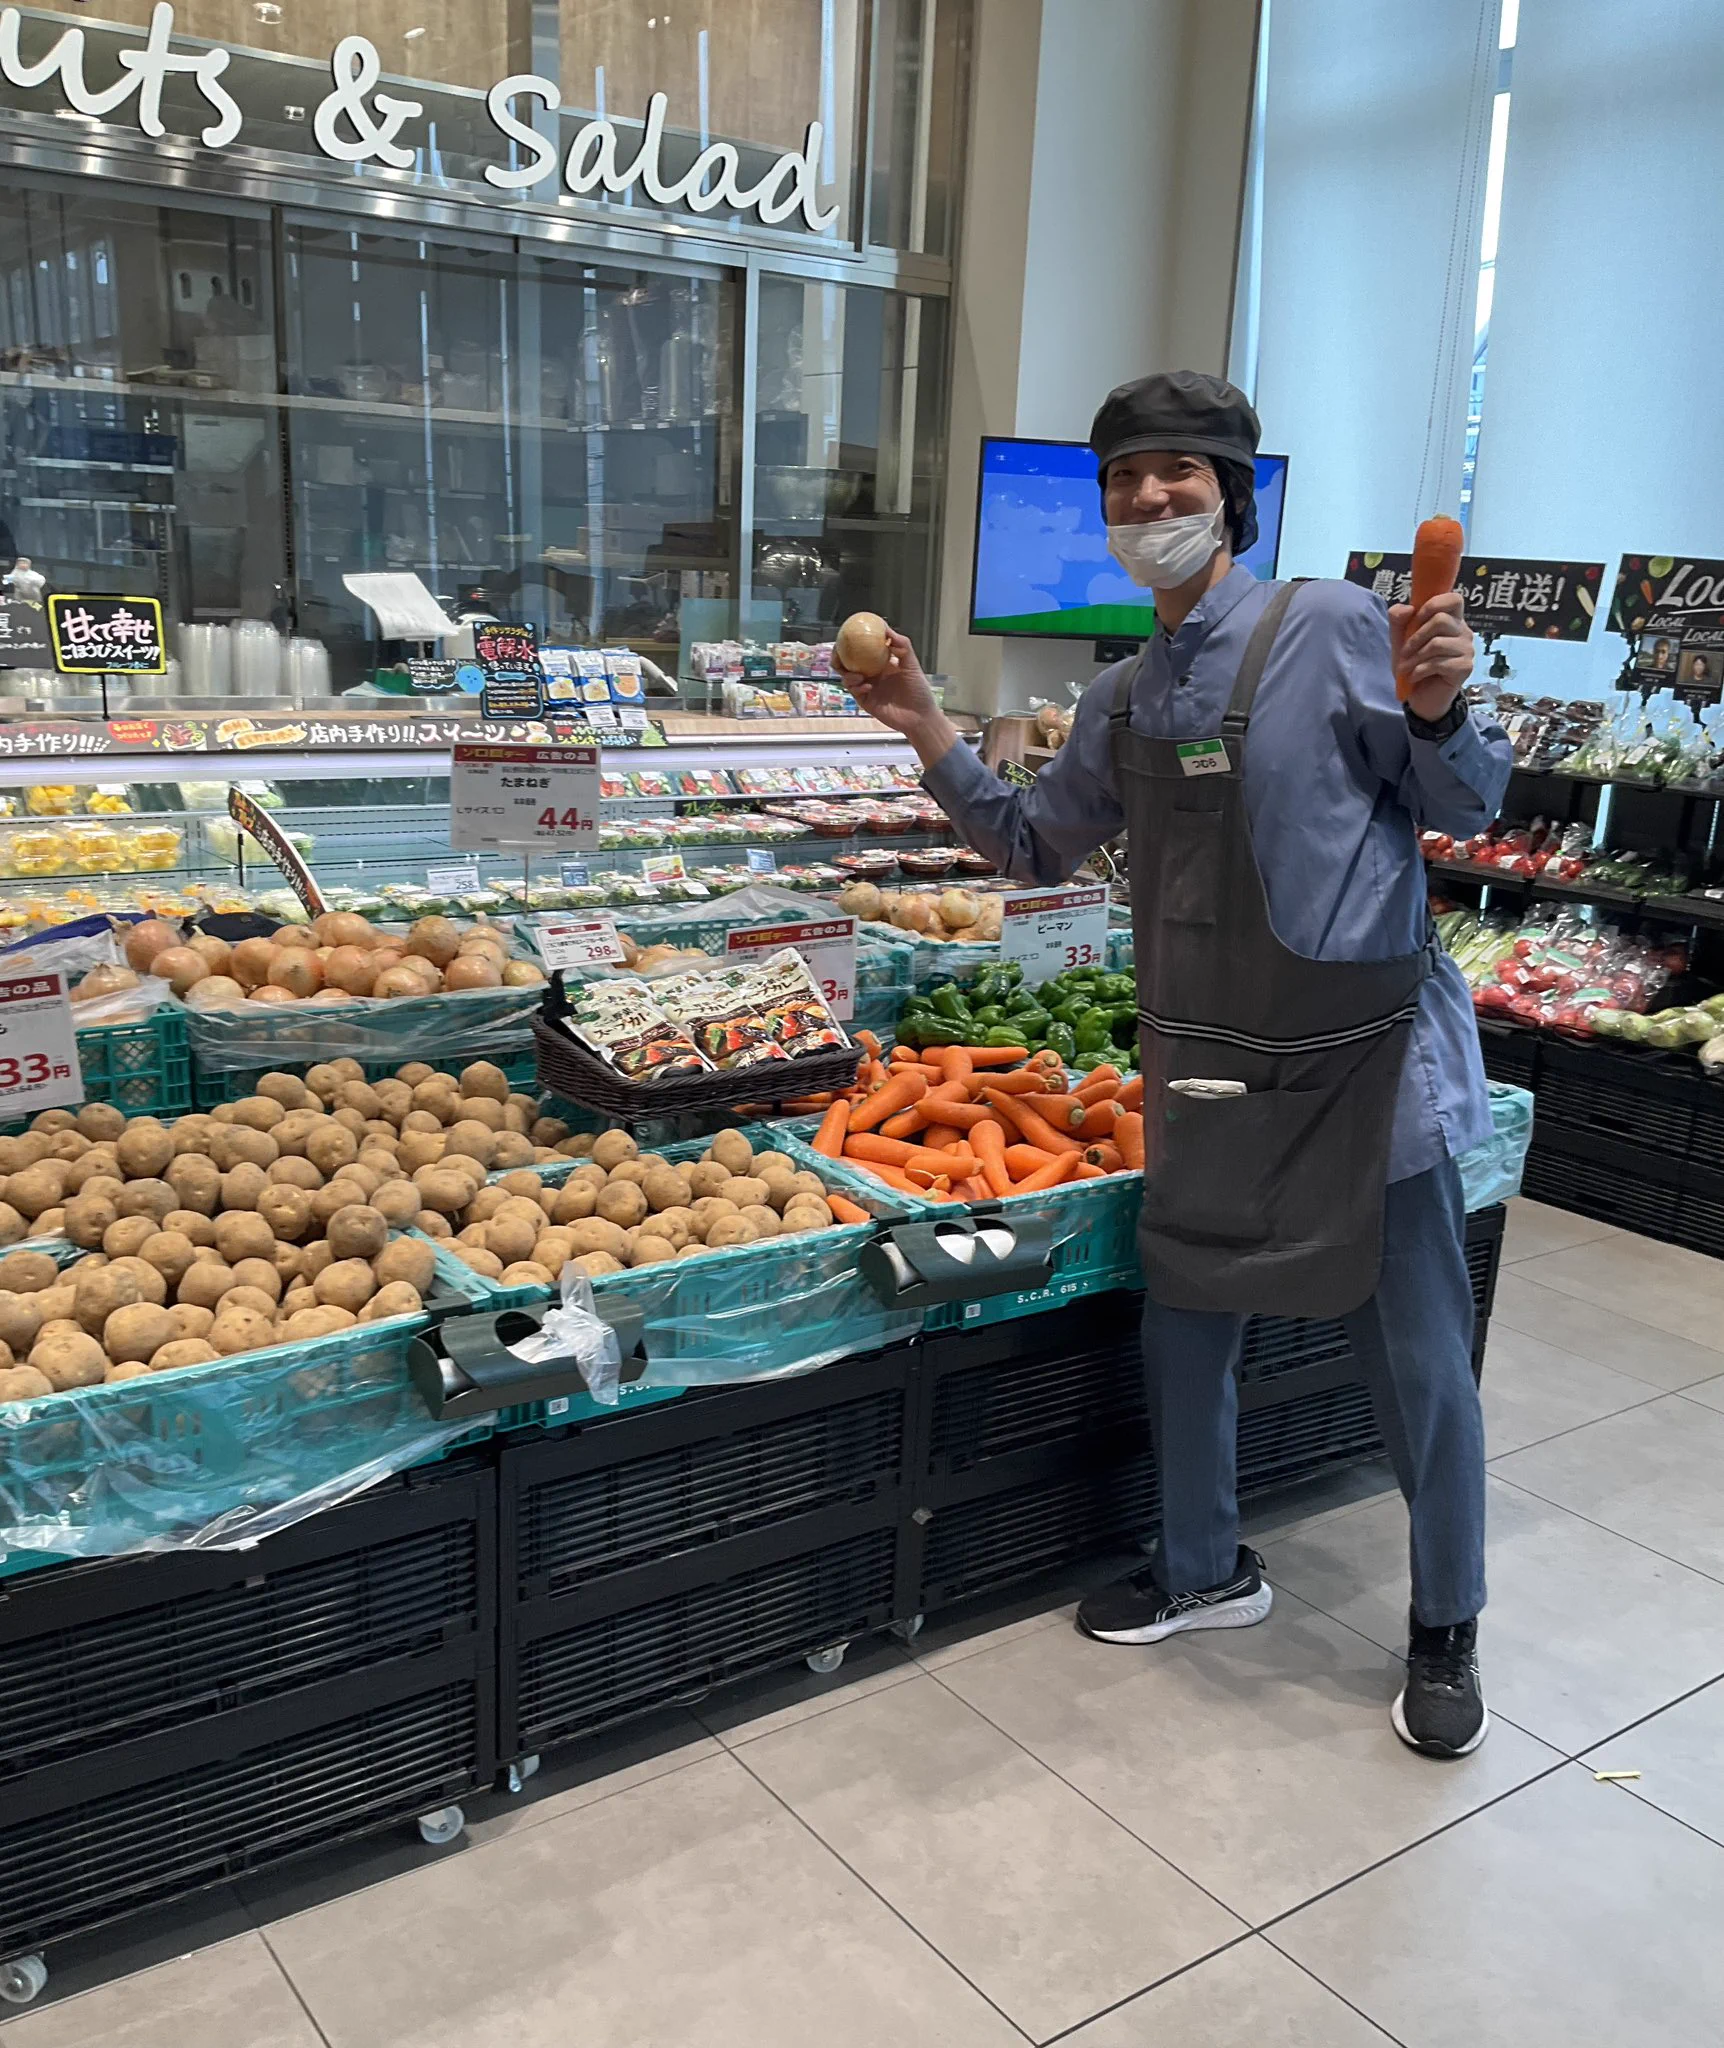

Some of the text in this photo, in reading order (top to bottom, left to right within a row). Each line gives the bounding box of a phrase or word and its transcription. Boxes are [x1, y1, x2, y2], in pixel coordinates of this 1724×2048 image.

[313, 35, 423, 168] &
[484, 74, 841, 232] Salad
[60, 607, 155, 644] 甘くて幸せ
[500, 777, 551, 789] たまねぎ
[1037, 922, 1074, 935] ピーマン
[1017, 1288, 1055, 1303] S.C.R.
[1060, 1282, 1078, 1294] 615
